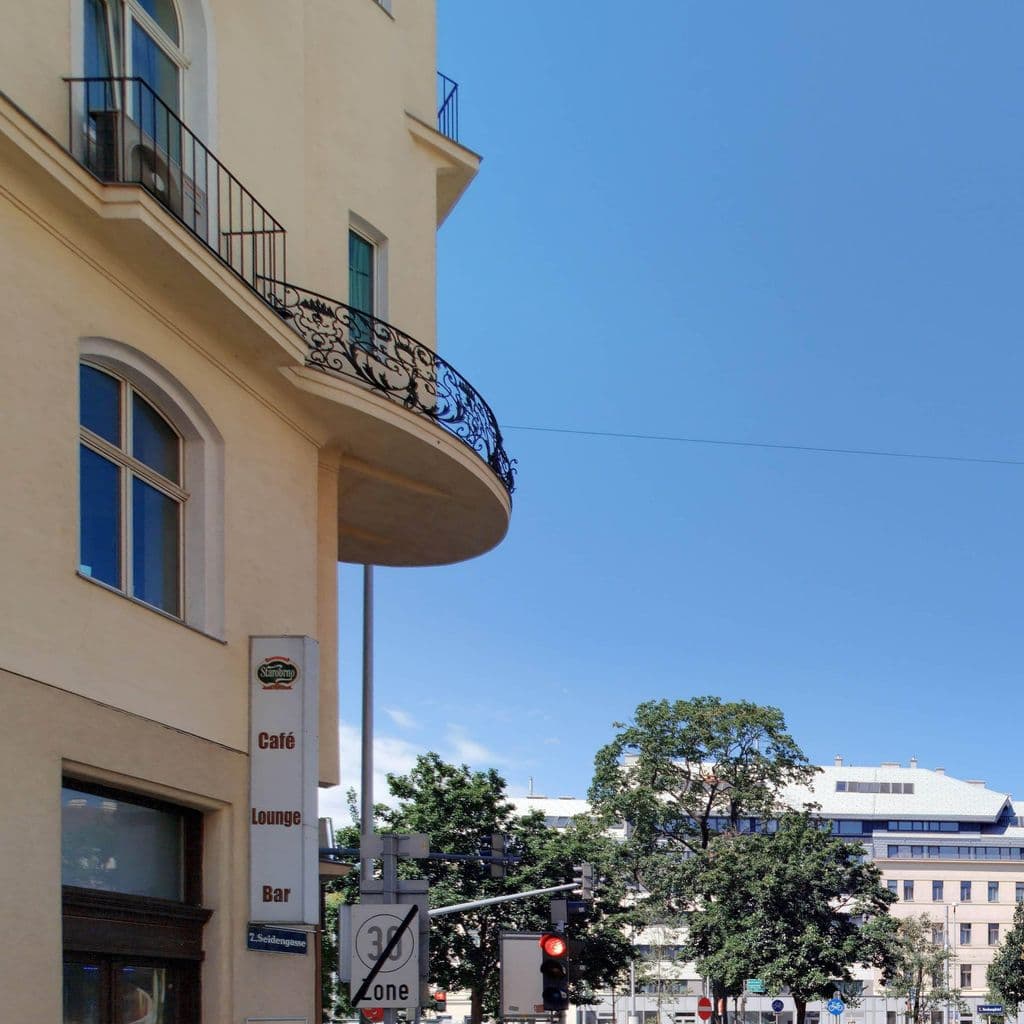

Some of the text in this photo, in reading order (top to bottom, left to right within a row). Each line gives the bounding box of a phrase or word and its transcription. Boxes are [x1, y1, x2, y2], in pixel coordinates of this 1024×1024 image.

[258, 731, 296, 750] Café
[251, 807, 301, 827] Lounge
[262, 885, 291, 903] Bar
[367, 925, 402, 961] 30
